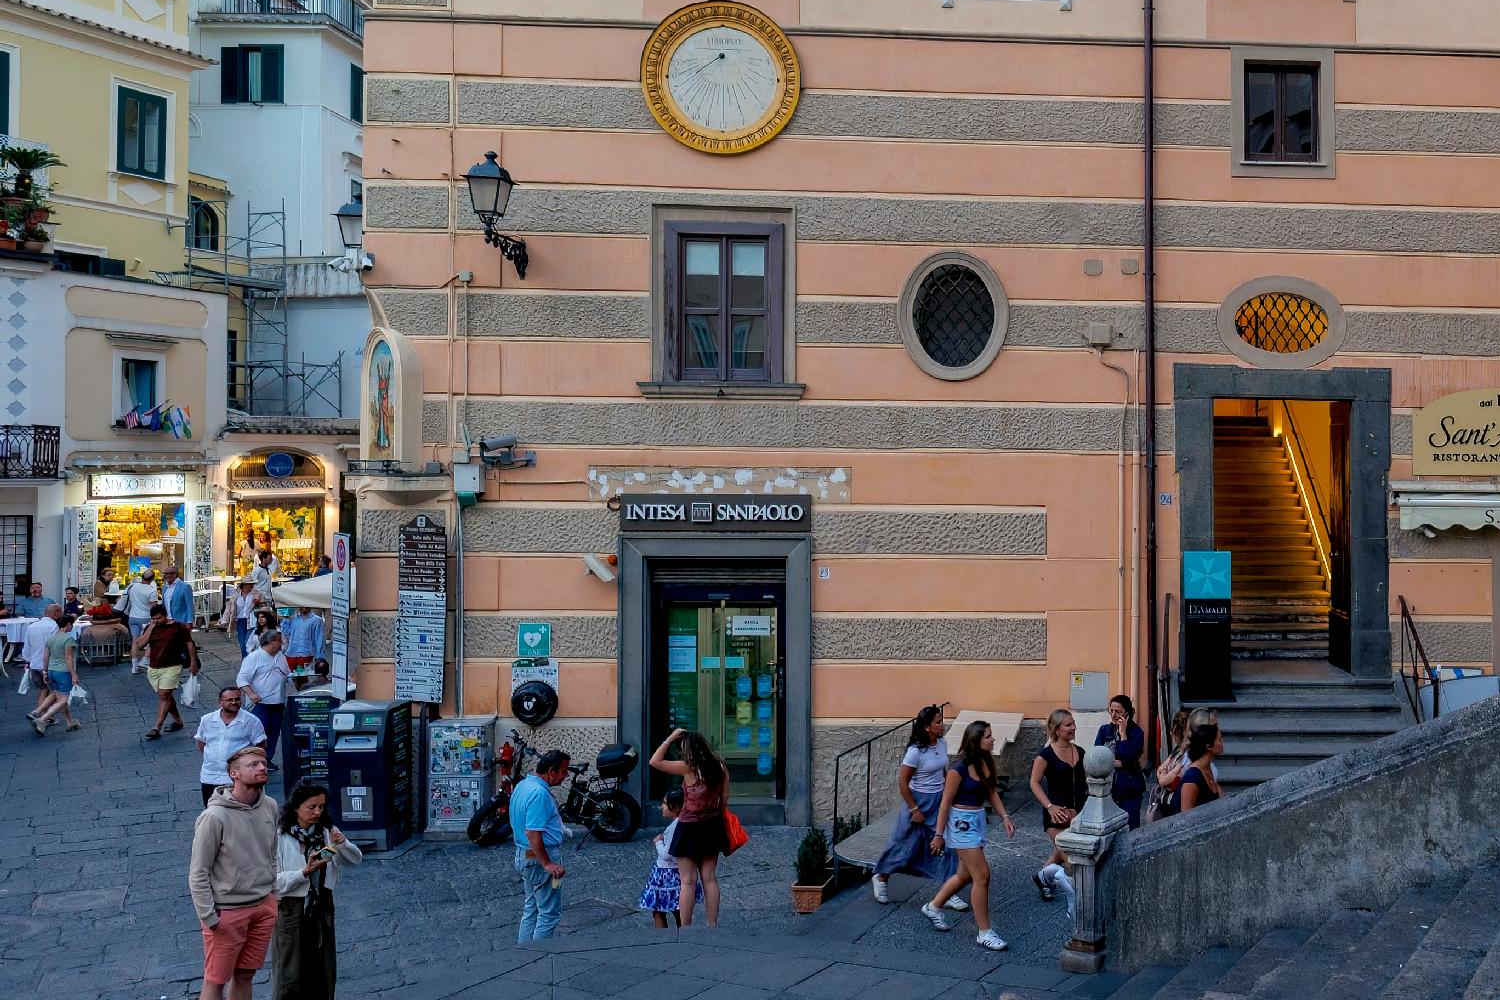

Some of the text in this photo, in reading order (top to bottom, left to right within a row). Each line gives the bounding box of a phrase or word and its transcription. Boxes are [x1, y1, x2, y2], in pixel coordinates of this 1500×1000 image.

[1160, 494, 1172, 506] 24
[625, 503, 804, 521] INTESA SANPAOLO
[1484, 509, 1500, 525] S.
